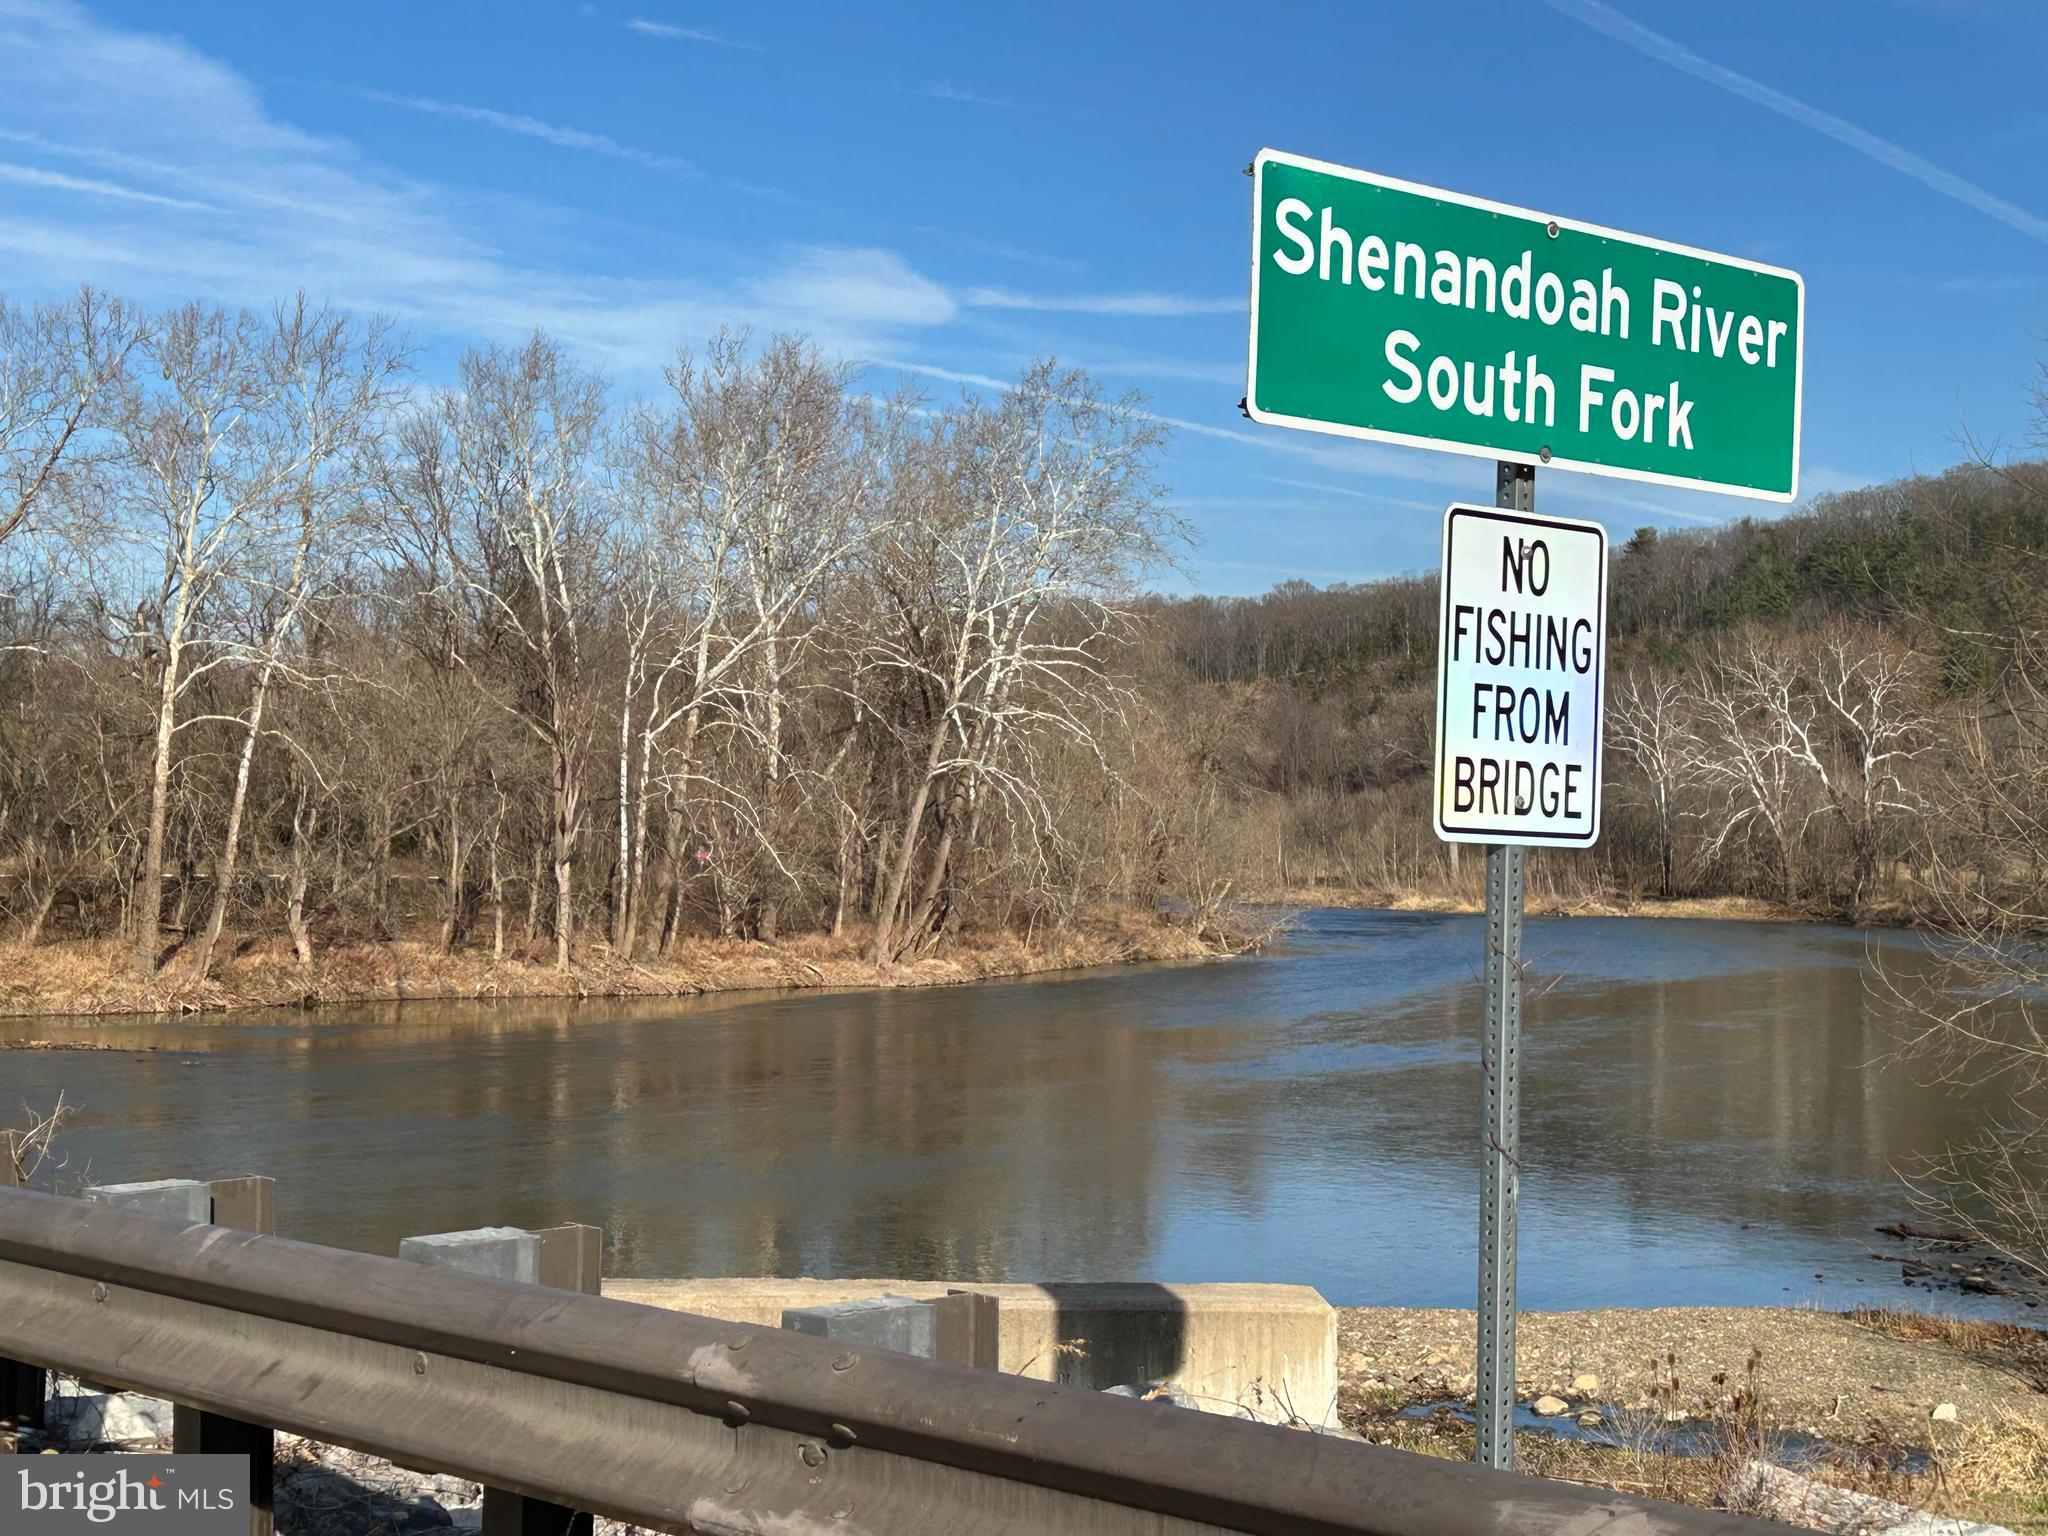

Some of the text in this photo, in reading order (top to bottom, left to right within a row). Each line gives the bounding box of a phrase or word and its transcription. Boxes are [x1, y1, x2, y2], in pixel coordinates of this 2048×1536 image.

[1273, 197, 1788, 368] Shenandoah River
[1382, 329, 1694, 450] South Fork
[1502, 536, 1549, 597] NO
[1454, 605, 1592, 674] FISHING
[1473, 683, 1570, 746] FROM
[1453, 756, 1582, 819] BRIDGE
